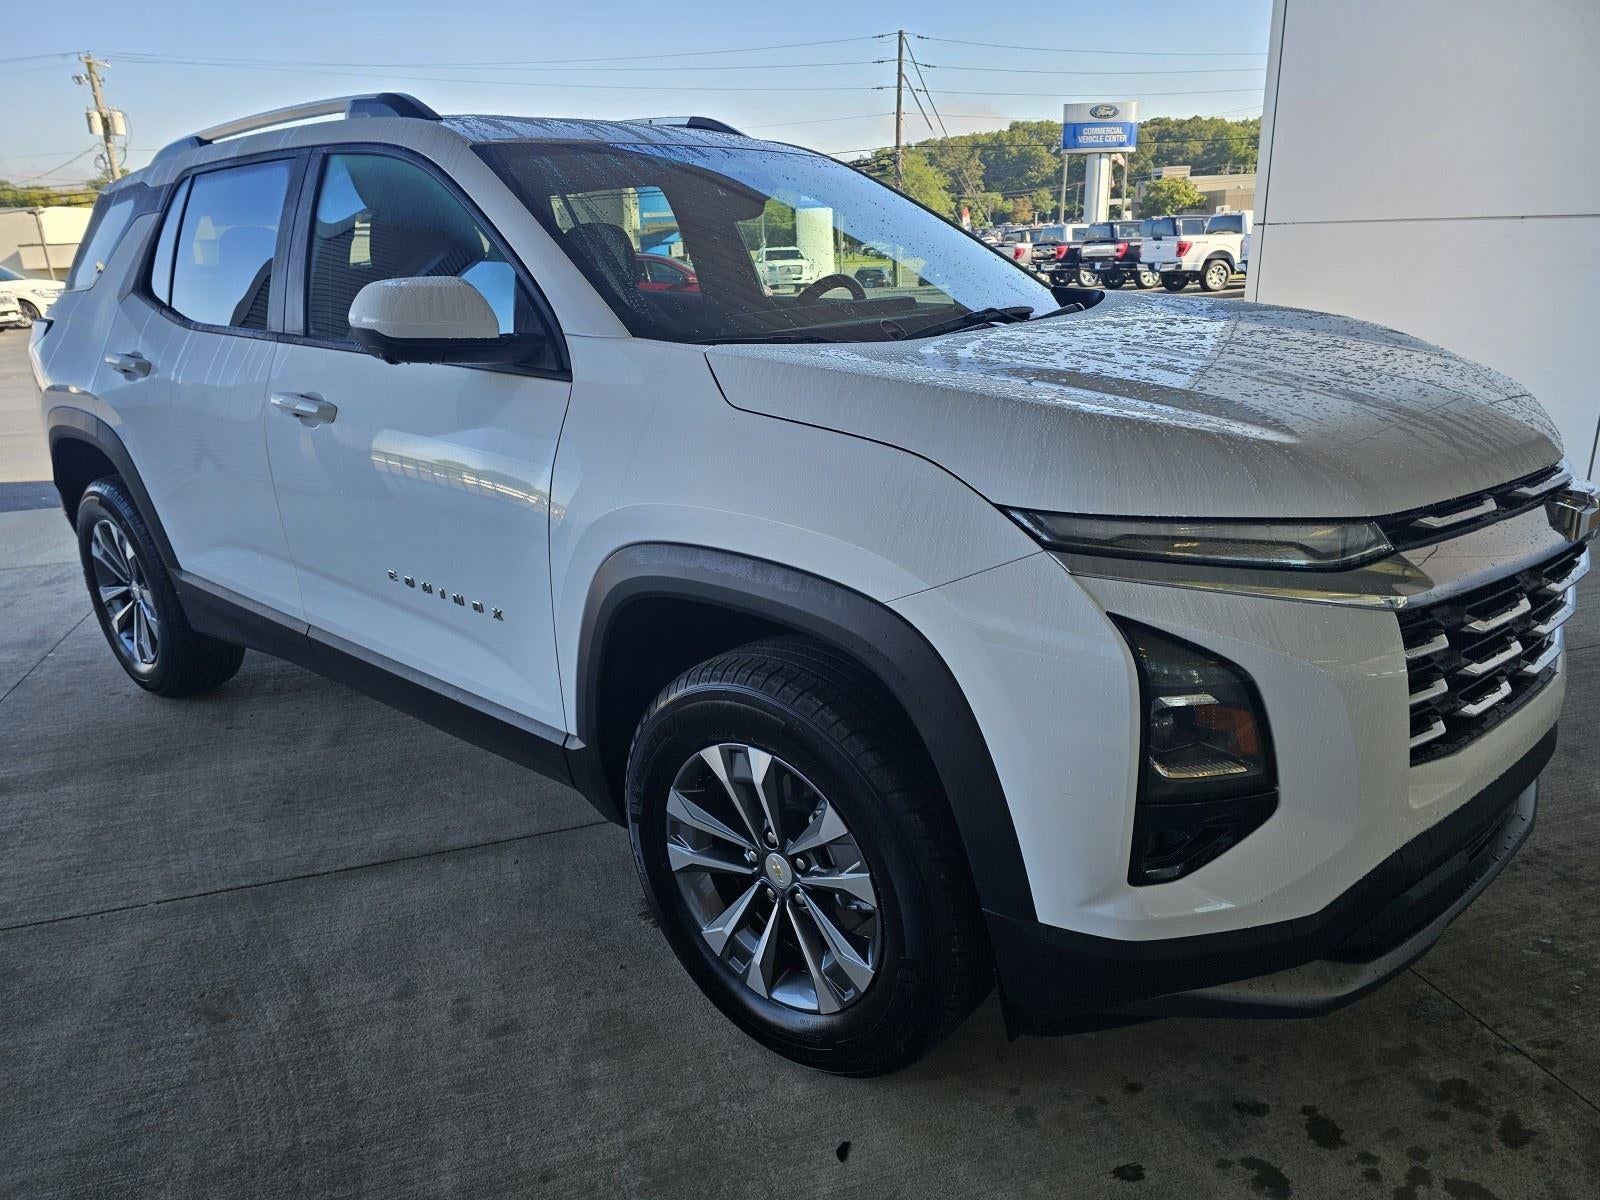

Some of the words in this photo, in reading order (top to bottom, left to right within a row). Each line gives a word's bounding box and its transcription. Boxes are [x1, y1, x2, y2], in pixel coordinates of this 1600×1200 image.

[1082, 126, 1124, 135] COMMERCIAL
[1078, 135, 1104, 143] VEHICLE
[1104, 134, 1127, 143] CENTER
[387, 568, 505, 622] EQUINOX
